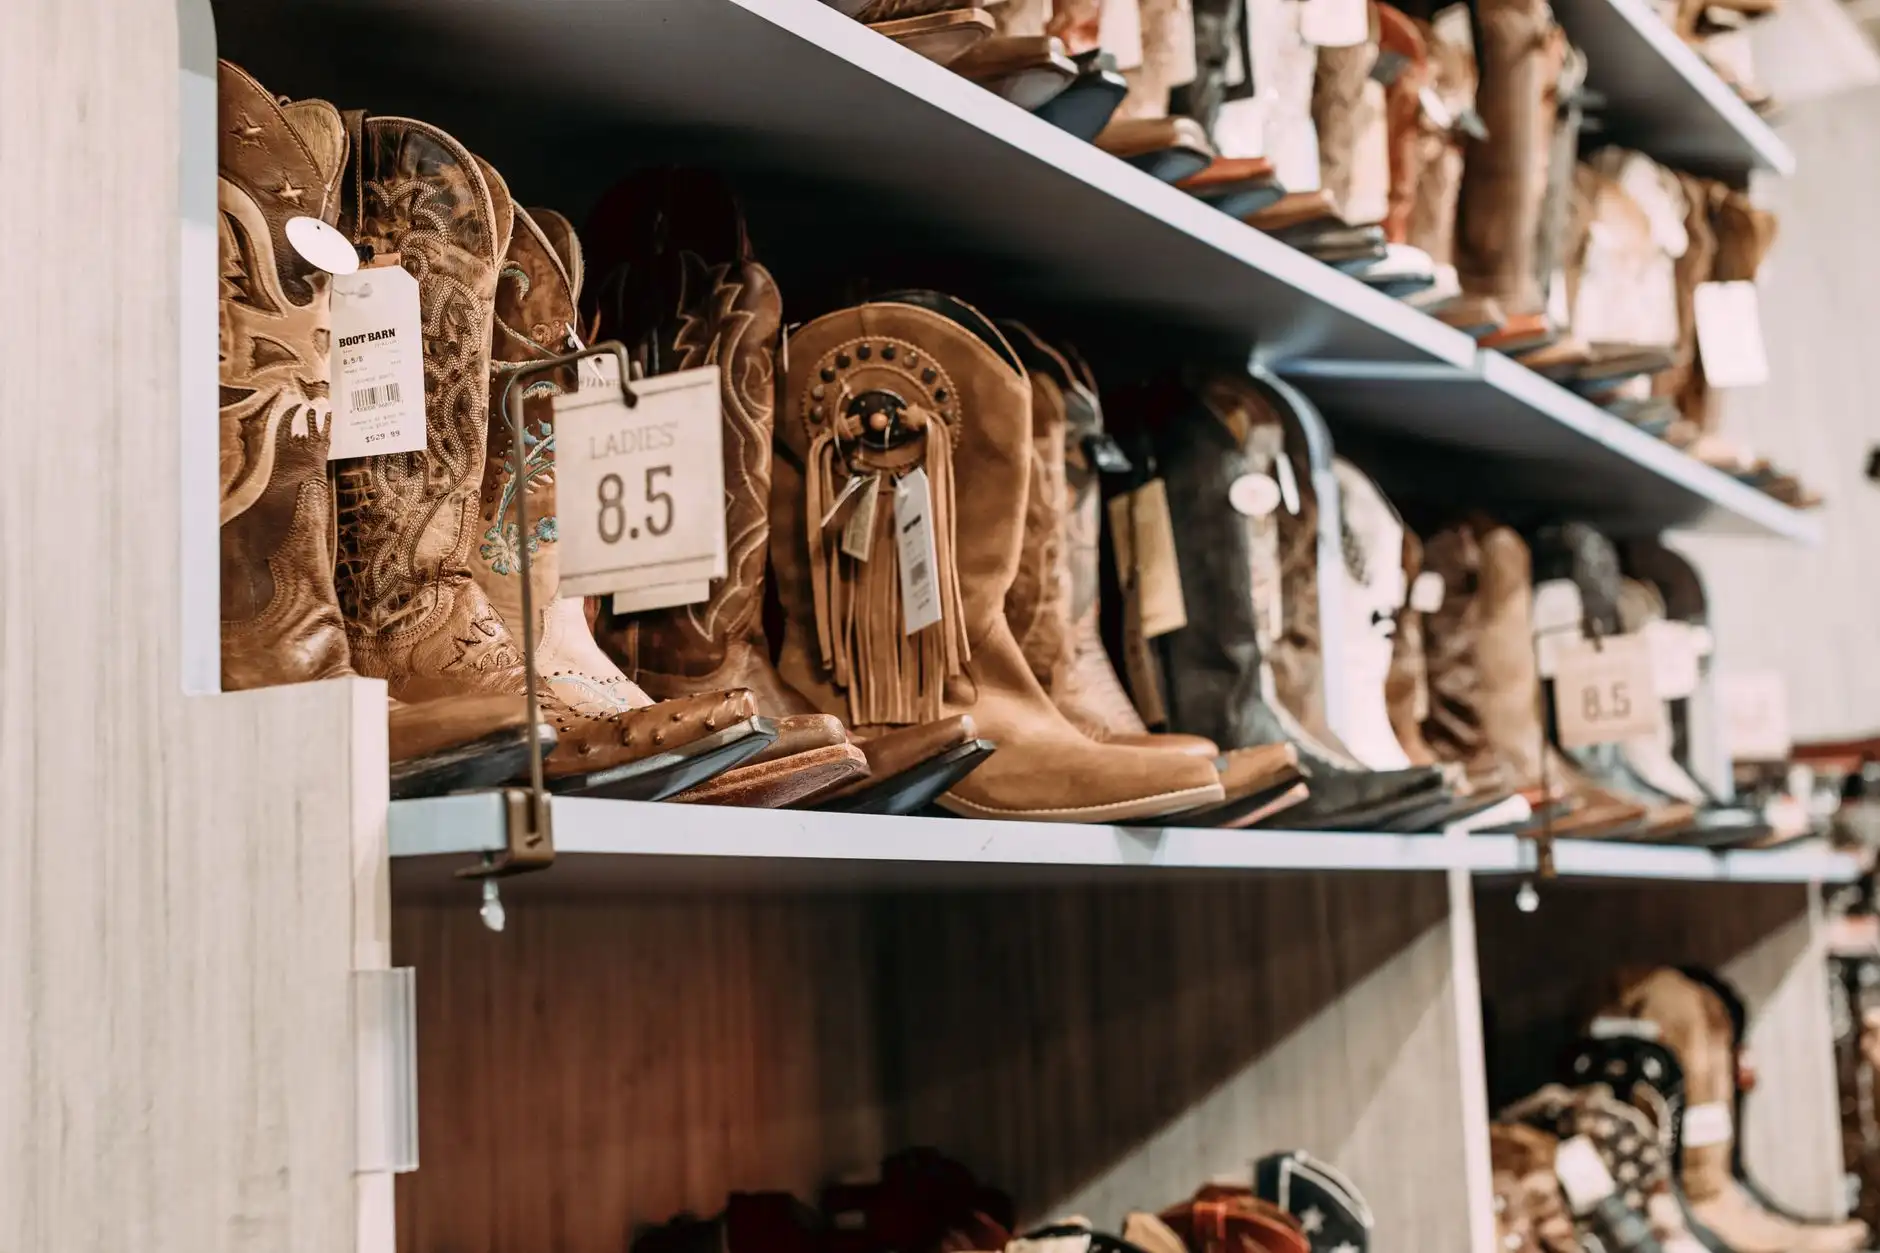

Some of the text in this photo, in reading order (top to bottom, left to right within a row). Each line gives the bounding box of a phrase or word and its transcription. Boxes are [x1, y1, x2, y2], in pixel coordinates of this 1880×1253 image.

[339, 334, 366, 348] BOOT
[367, 328, 396, 342] BARN
[598, 465, 675, 545] 8.5
[1581, 682, 1631, 722] 8.5
